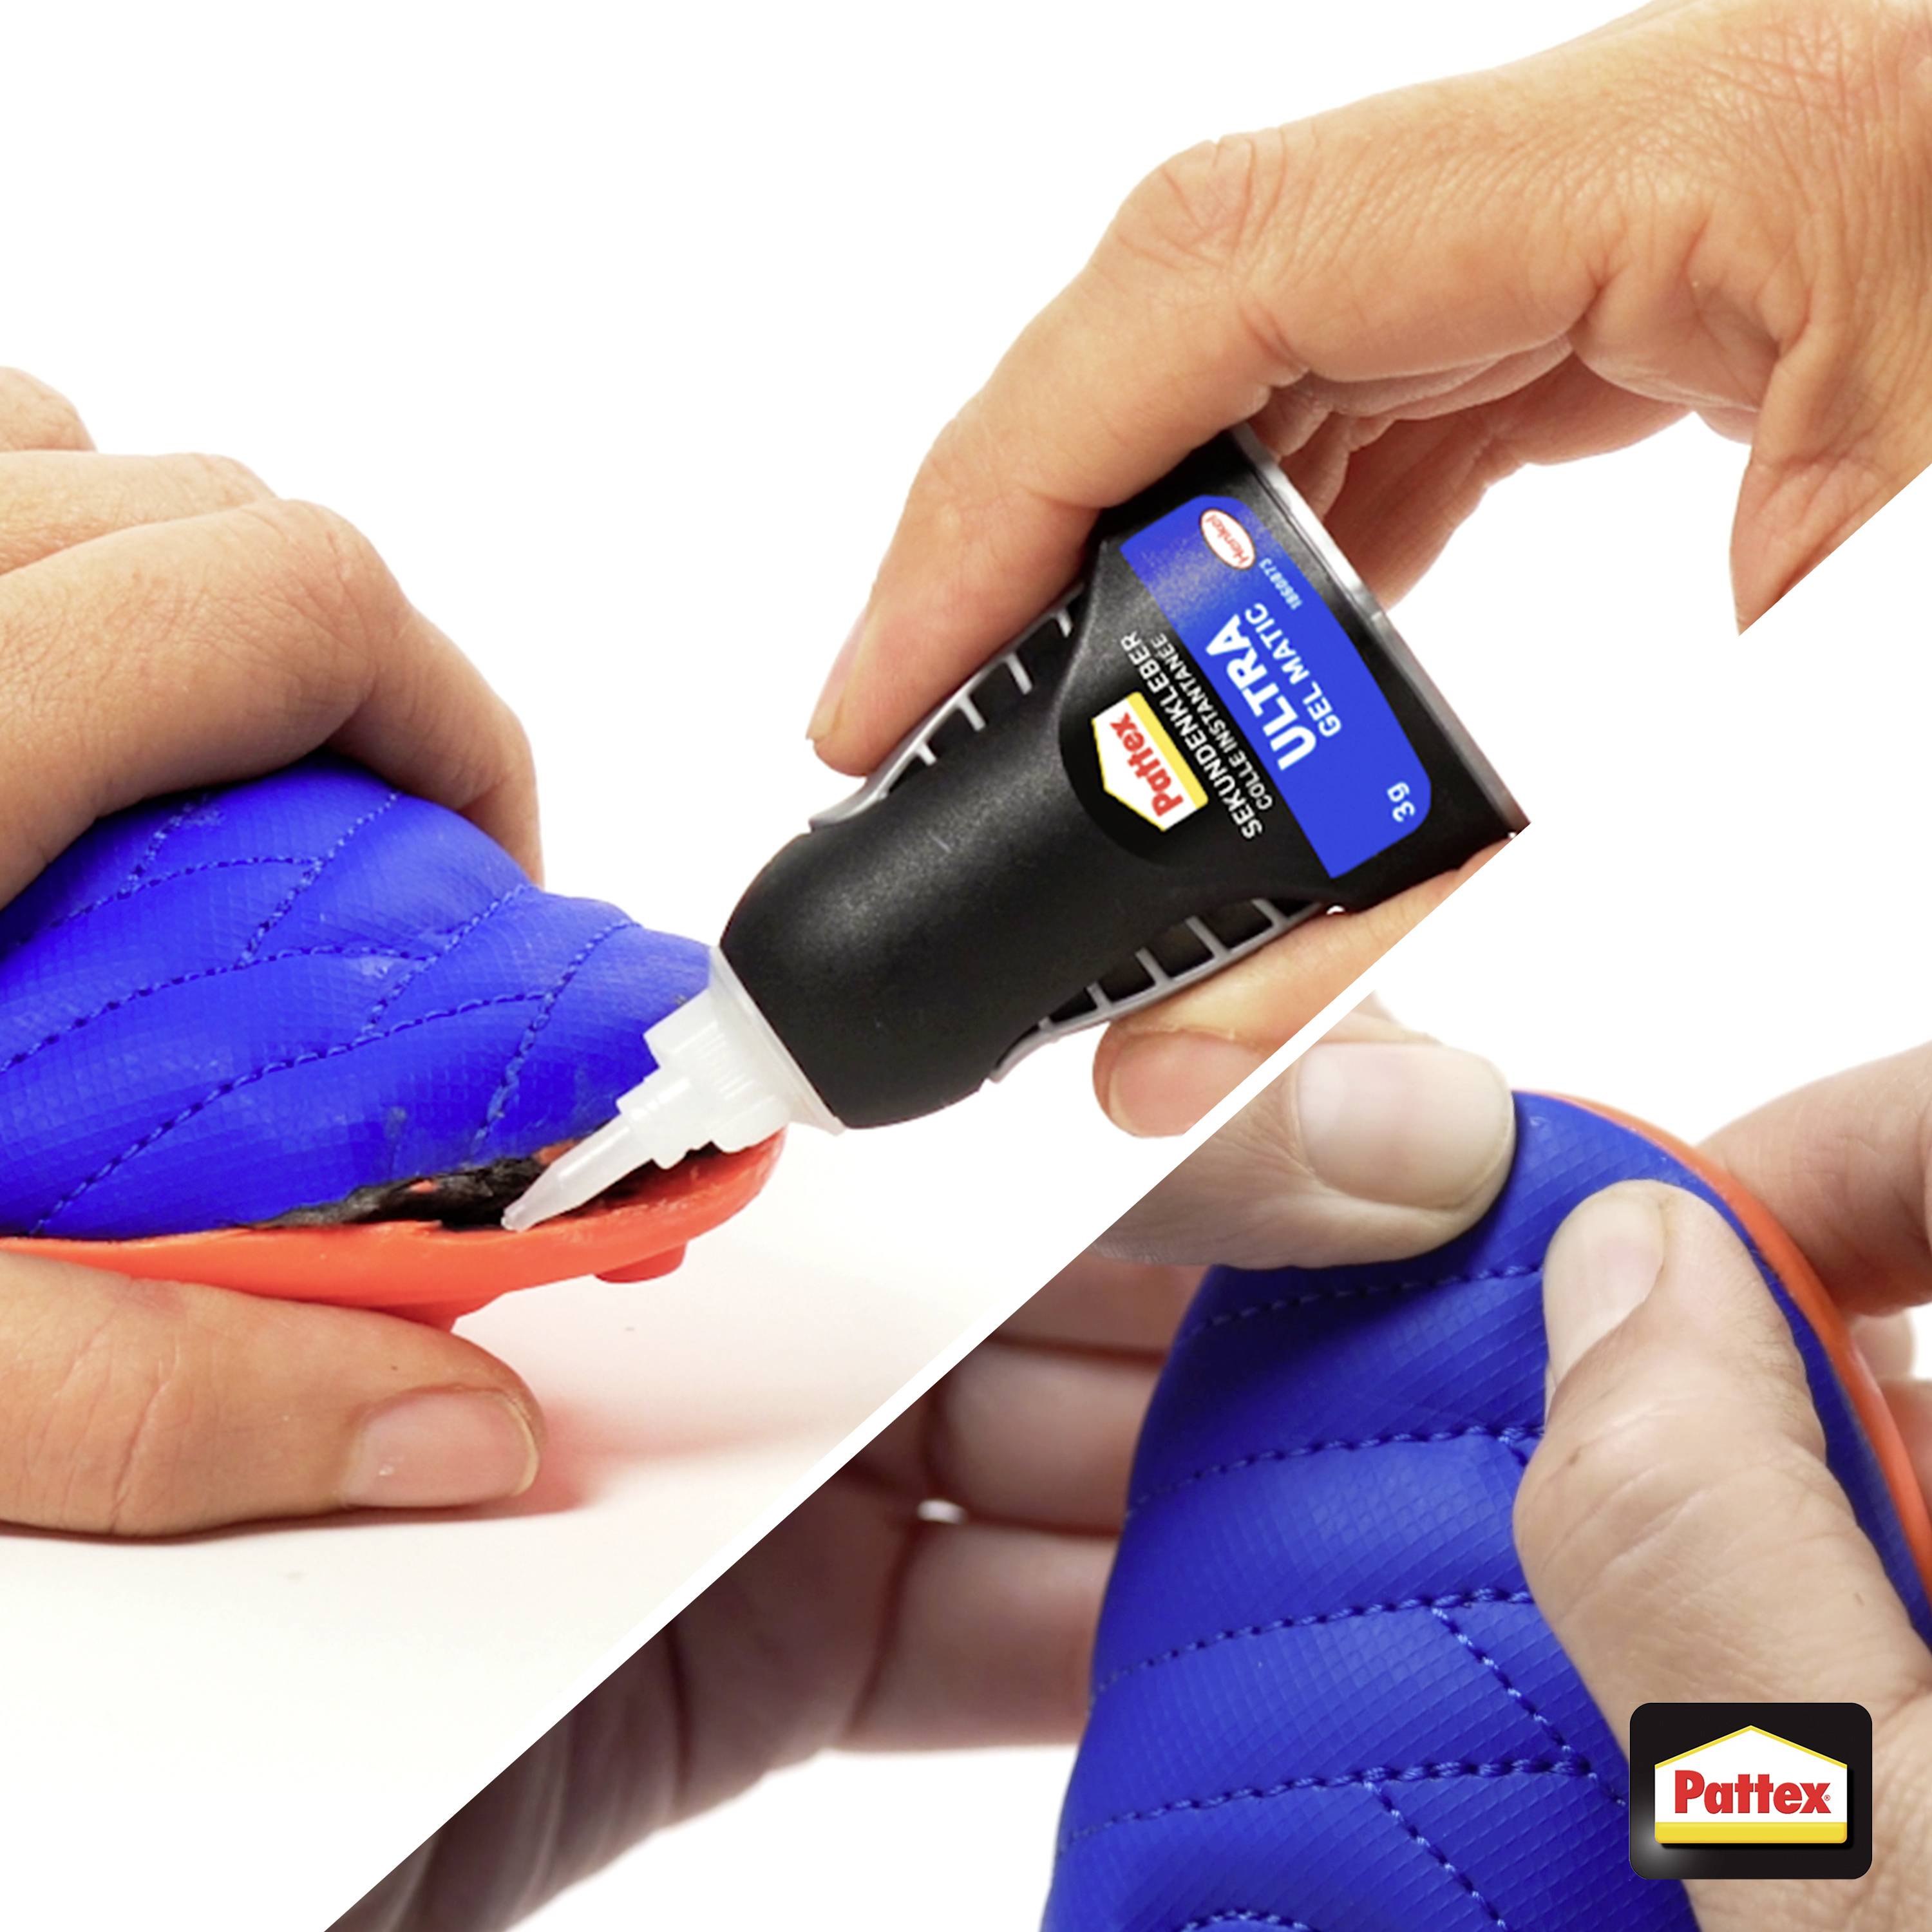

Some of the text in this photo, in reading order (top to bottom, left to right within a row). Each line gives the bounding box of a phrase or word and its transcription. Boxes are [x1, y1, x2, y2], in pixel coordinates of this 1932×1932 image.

[1206, 515, 1249, 564] Henkel
[1121, 631, 1262, 838] SEKUNDENKLEBER
[1150, 633, 1273, 810] COLLE INSTANTANÉE
[1206, 614, 1317, 770] ULTRA
[1244, 602, 1342, 737] GEL MATIC
[1110, 712, 1184, 817] Pattex
[1387, 781, 1416, 822] 3g
